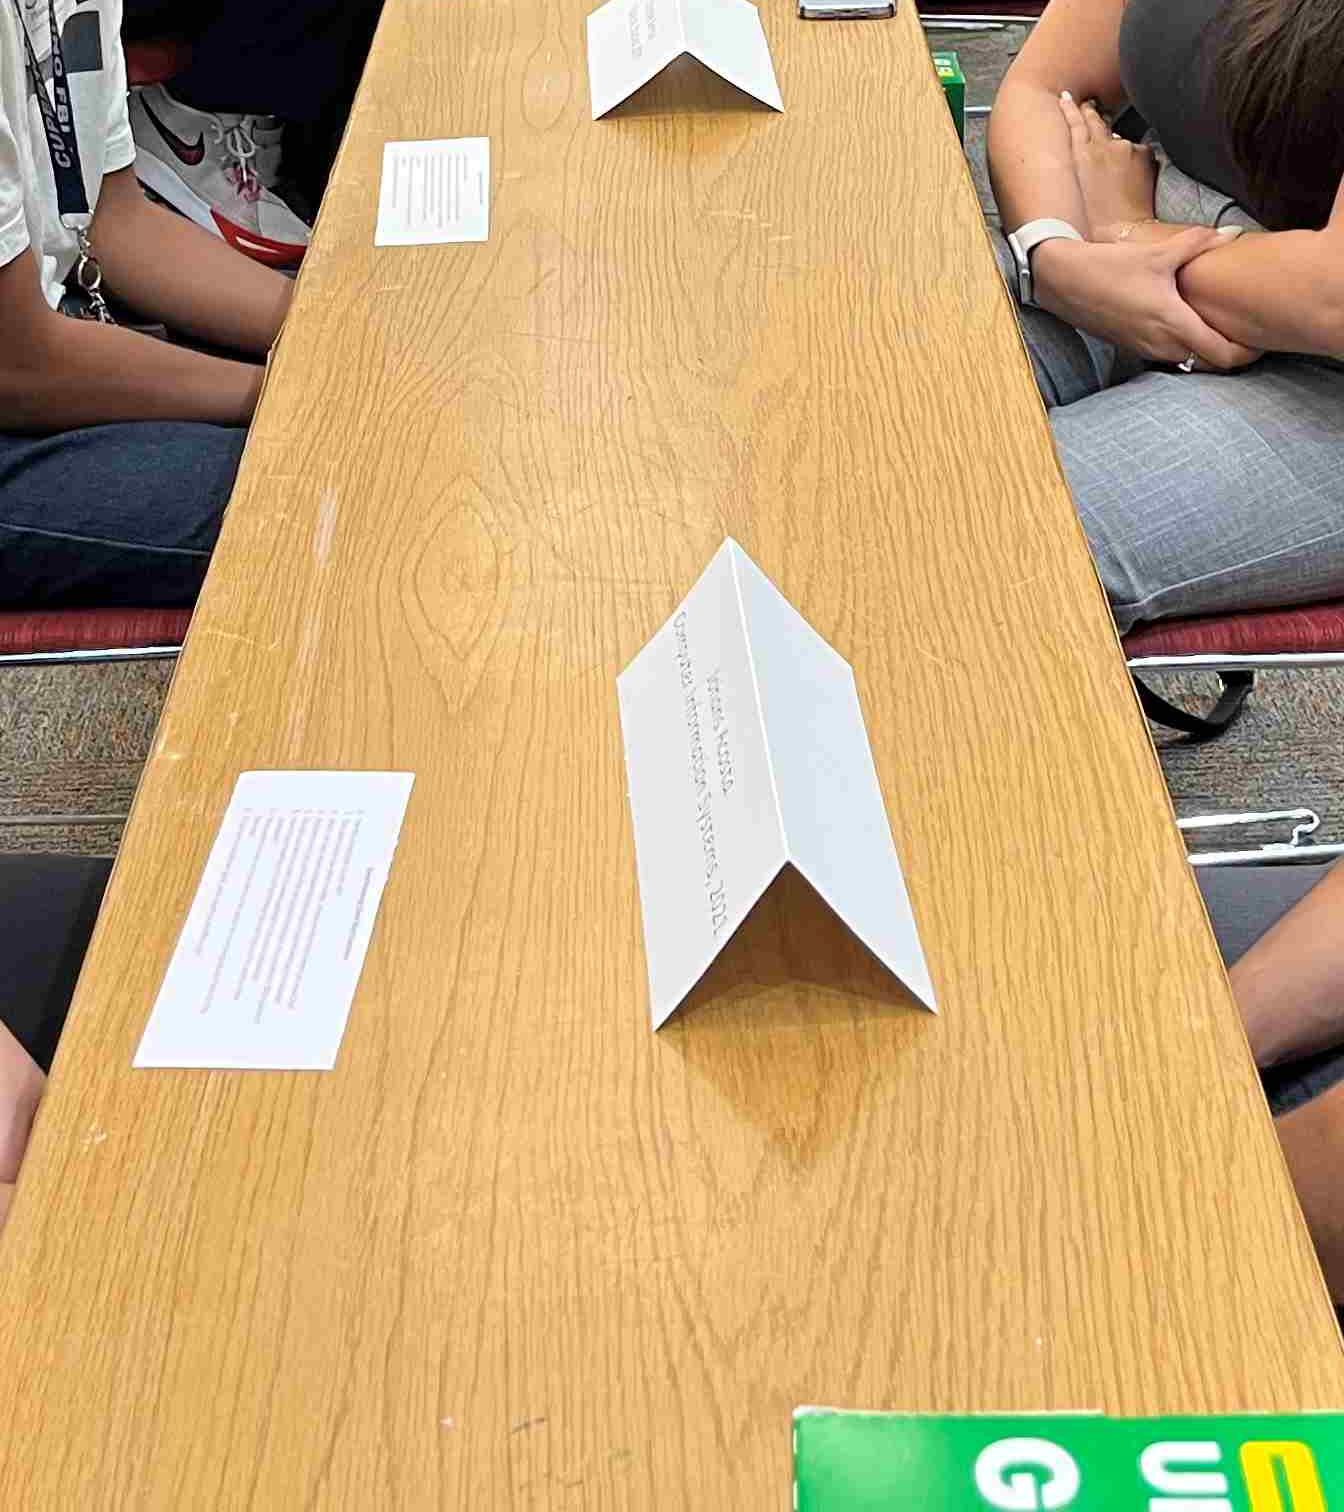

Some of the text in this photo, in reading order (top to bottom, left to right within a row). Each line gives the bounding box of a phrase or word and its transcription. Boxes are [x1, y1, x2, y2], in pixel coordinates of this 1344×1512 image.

[672, 609, 694, 687] Computer
[686, 687, 709, 795] Information
[695, 794, 720, 888] Systems,
